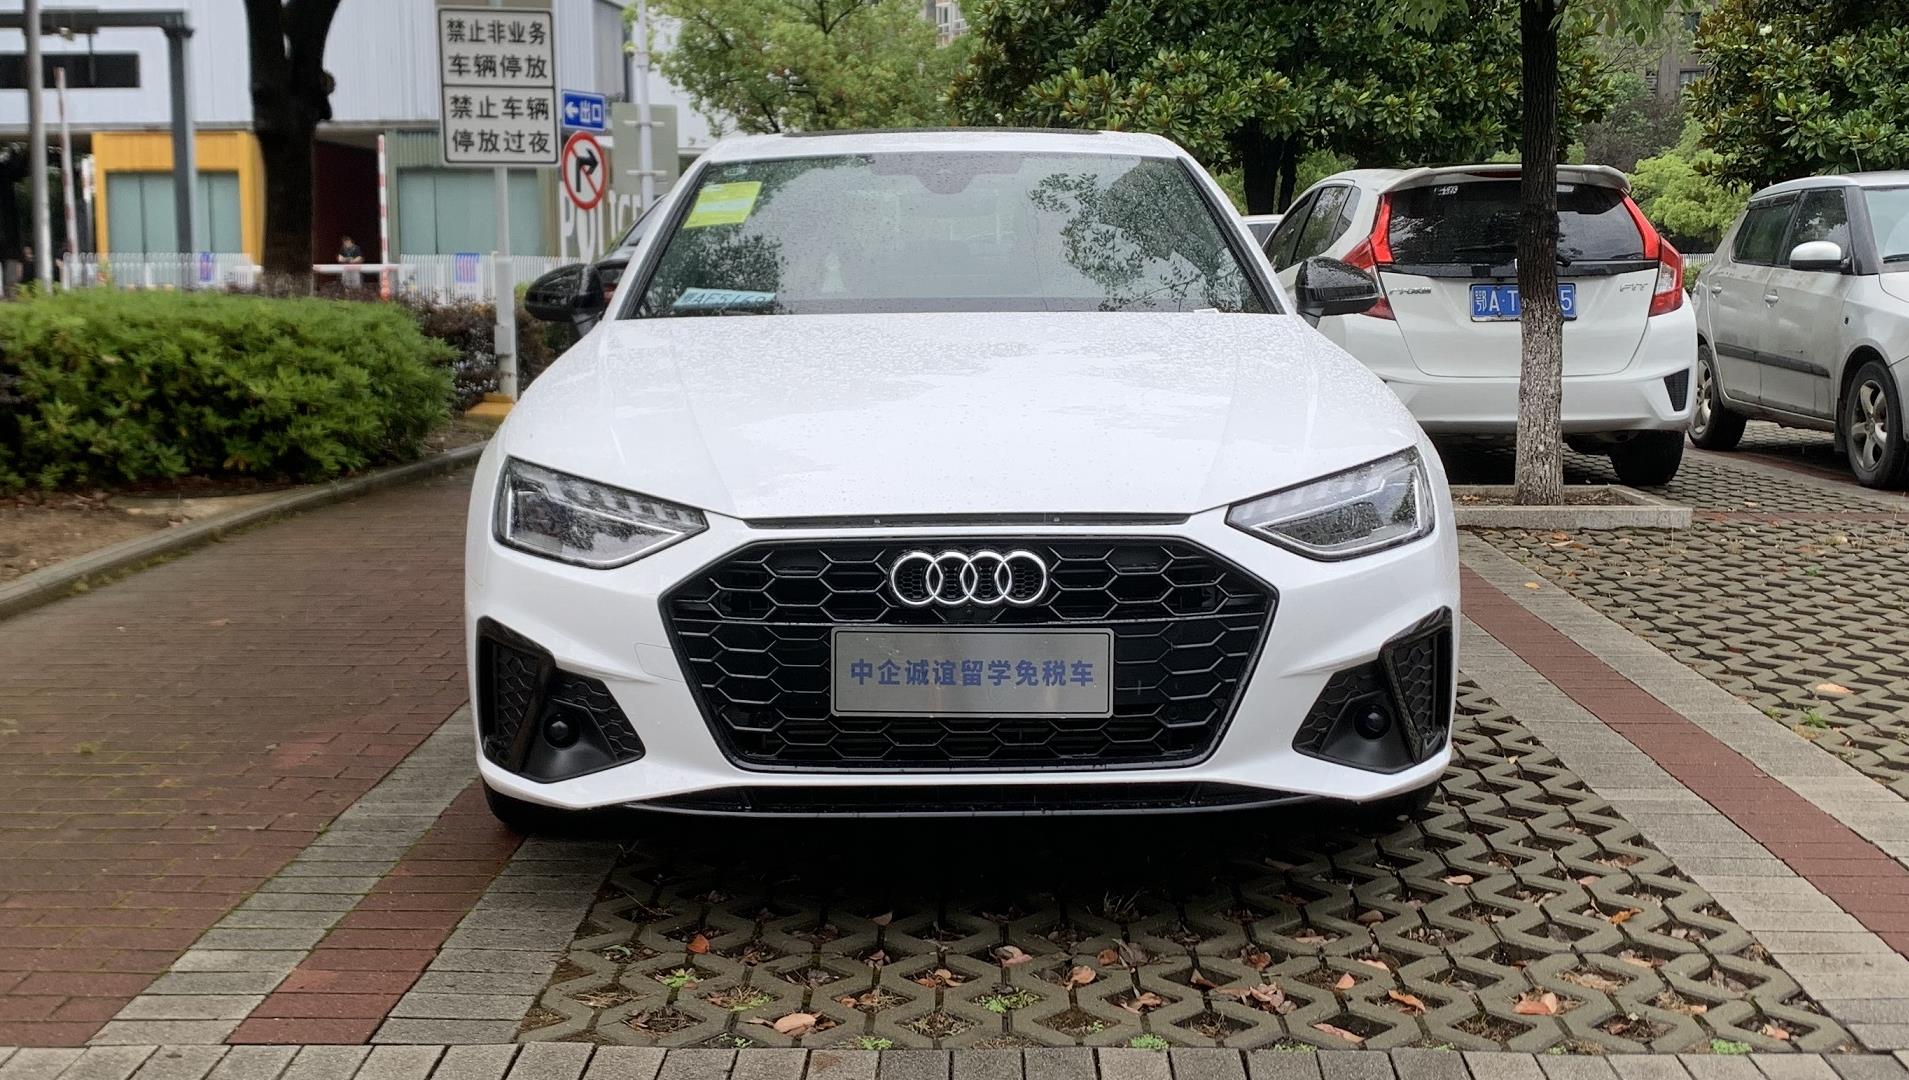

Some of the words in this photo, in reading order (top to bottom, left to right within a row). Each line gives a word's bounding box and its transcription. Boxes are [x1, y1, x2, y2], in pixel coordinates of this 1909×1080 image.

[446, 20, 546, 44] 禁止非业务
[448, 53, 548, 79] 车辆停放
[450, 94, 549, 120] 禁止车辆
[579, 100, 602, 123] 出口
[452, 128, 551, 153] 停放过夜
[1474, 289, 1572, 311] 鄂A·T5
[850, 658, 1094, 687] 中企诚谊留学免税车
